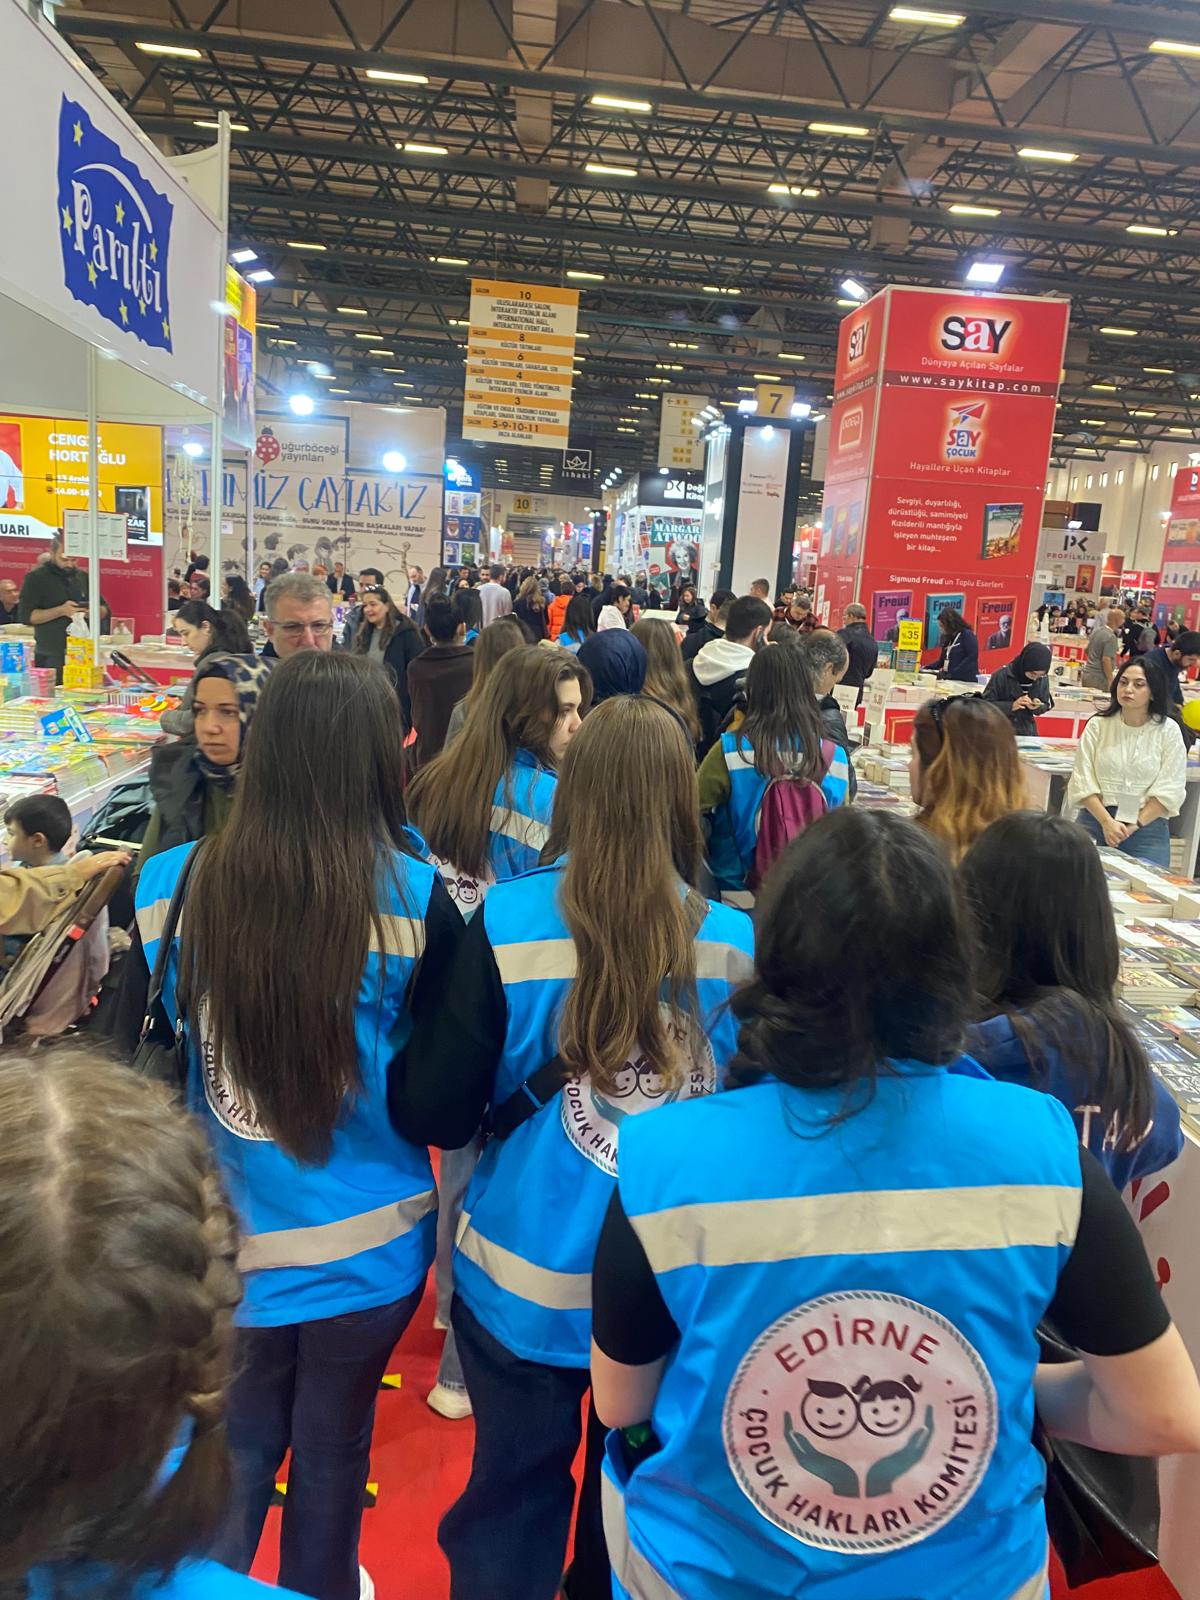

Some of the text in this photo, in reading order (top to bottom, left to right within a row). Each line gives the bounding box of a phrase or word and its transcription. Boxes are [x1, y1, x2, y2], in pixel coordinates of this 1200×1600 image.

[71, 179, 162, 312] Parıltı
[520, 290, 532, 300] 10
[519, 333, 526, 342] 8
[517, 352, 524, 360] 6
[921, 356, 1024, 373] Dünyaya Açılan Sayfalar
[516, 372, 522, 380] 4
[900, 374, 1042, 393] www.saykitap.com
[514, 397, 520, 406] 3
[769, 392, 784, 414] 7
[492, 420, 539, 432] 5-9-10-11
[281, 441, 340, 454] uğurböceği
[946, 448, 977, 458] ÇOCUK
[49, 449, 126, 466] HORTĞLU
[281, 452, 324, 464] yayınları
[910, 461, 1012, 477] Hayallere Uçan Kitaplar
[516, 499, 530, 510] 10
[896, 496, 923, 507] Sevgiyi,
[930, 510, 968, 520] samimiyeti
[926, 522, 963, 532] mantığıyla
[920, 534, 958, 543] muhteşem
[890, 574, 920, 584] Sigmund
[956, 578, 974, 588] Toplu
[976, 580, 1004, 589] Eserleri
[879, 596, 910, 608] Freud
[933, 600, 962, 611] Freud
[982, 602, 1013, 614] Freud
[774, 1313, 940, 1374] EDİRNE
[739, 1394, 978, 1535] ÇOCUK HAKLARI KOMİTESİ
